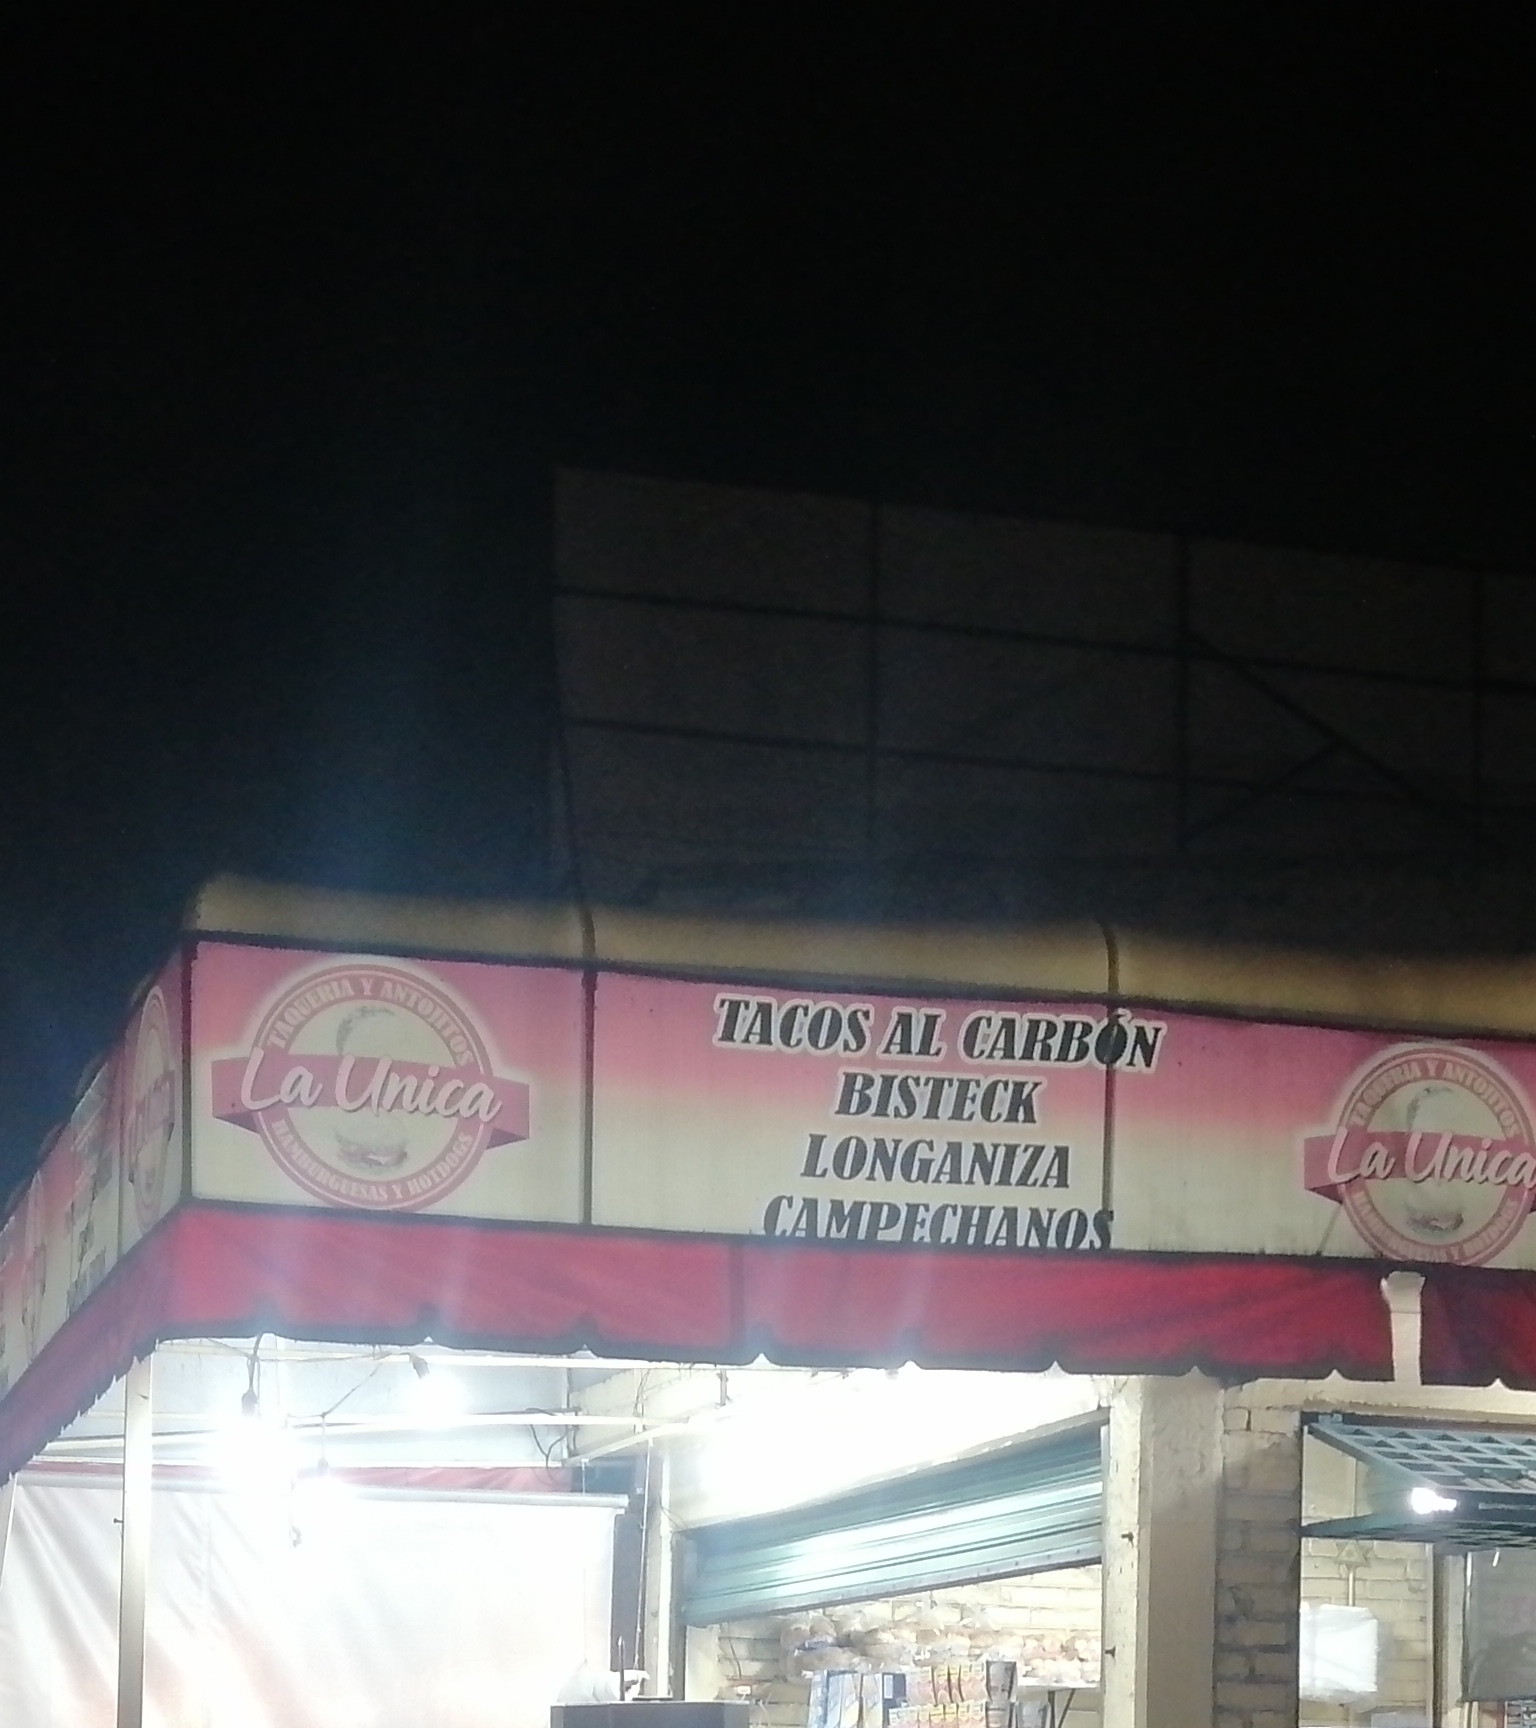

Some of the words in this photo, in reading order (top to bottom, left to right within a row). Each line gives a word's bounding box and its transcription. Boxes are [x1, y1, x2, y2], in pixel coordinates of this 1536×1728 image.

[268, 977, 355, 1050] TAQUERIA
[360, 977, 374, 996] Y
[380, 980, 476, 1067] ANTOJITOS
[718, 998, 871, 1054] TACOS
[883, 1011, 944, 1057] AL
[240, 1046, 323, 1112] La
[334, 1055, 503, 1124] Unica
[834, 1071, 1045, 1125] BISTECK
[271, 1118, 388, 1201] HAMBURGUESAS
[392, 1184, 405, 1200] Y
[800, 1133, 1071, 1190] LONGANIZA
[1327, 1126, 1396, 1185] La
[763, 1195, 1116, 1251] CAMPECHANOS
